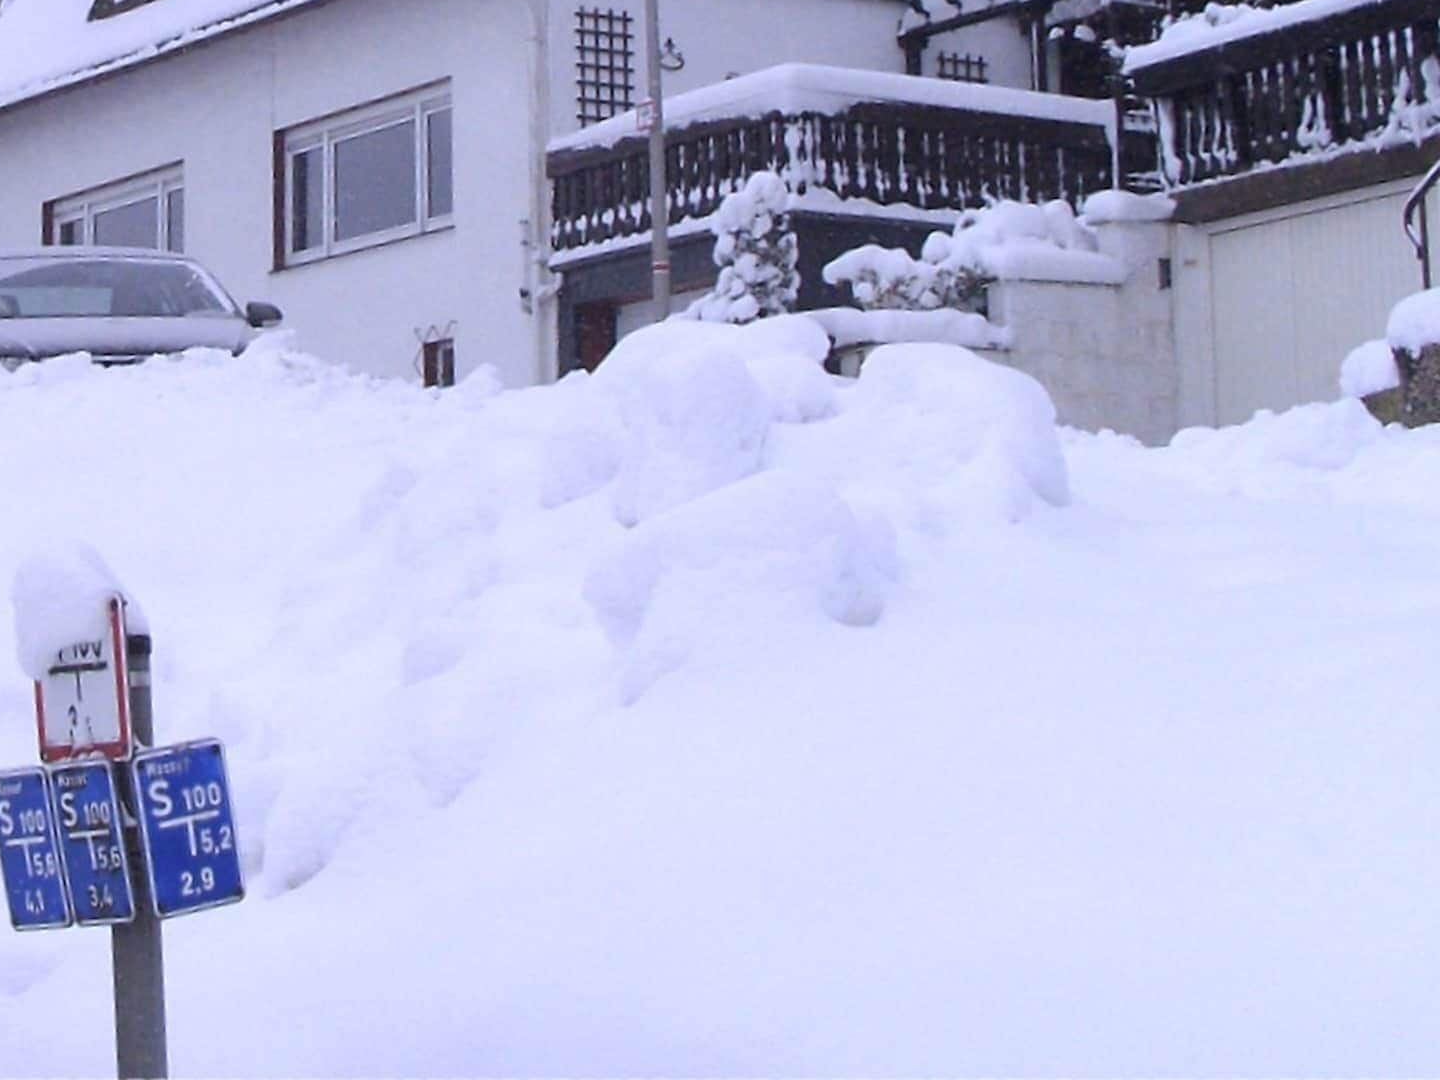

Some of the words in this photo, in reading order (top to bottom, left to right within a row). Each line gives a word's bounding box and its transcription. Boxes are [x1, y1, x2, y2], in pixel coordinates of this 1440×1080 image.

[61, 792, 78, 828] S
[83, 800, 110, 826] 100
[148, 779, 173, 817] S
[181, 781, 222, 812] 100
[19, 808, 46, 834] 100
